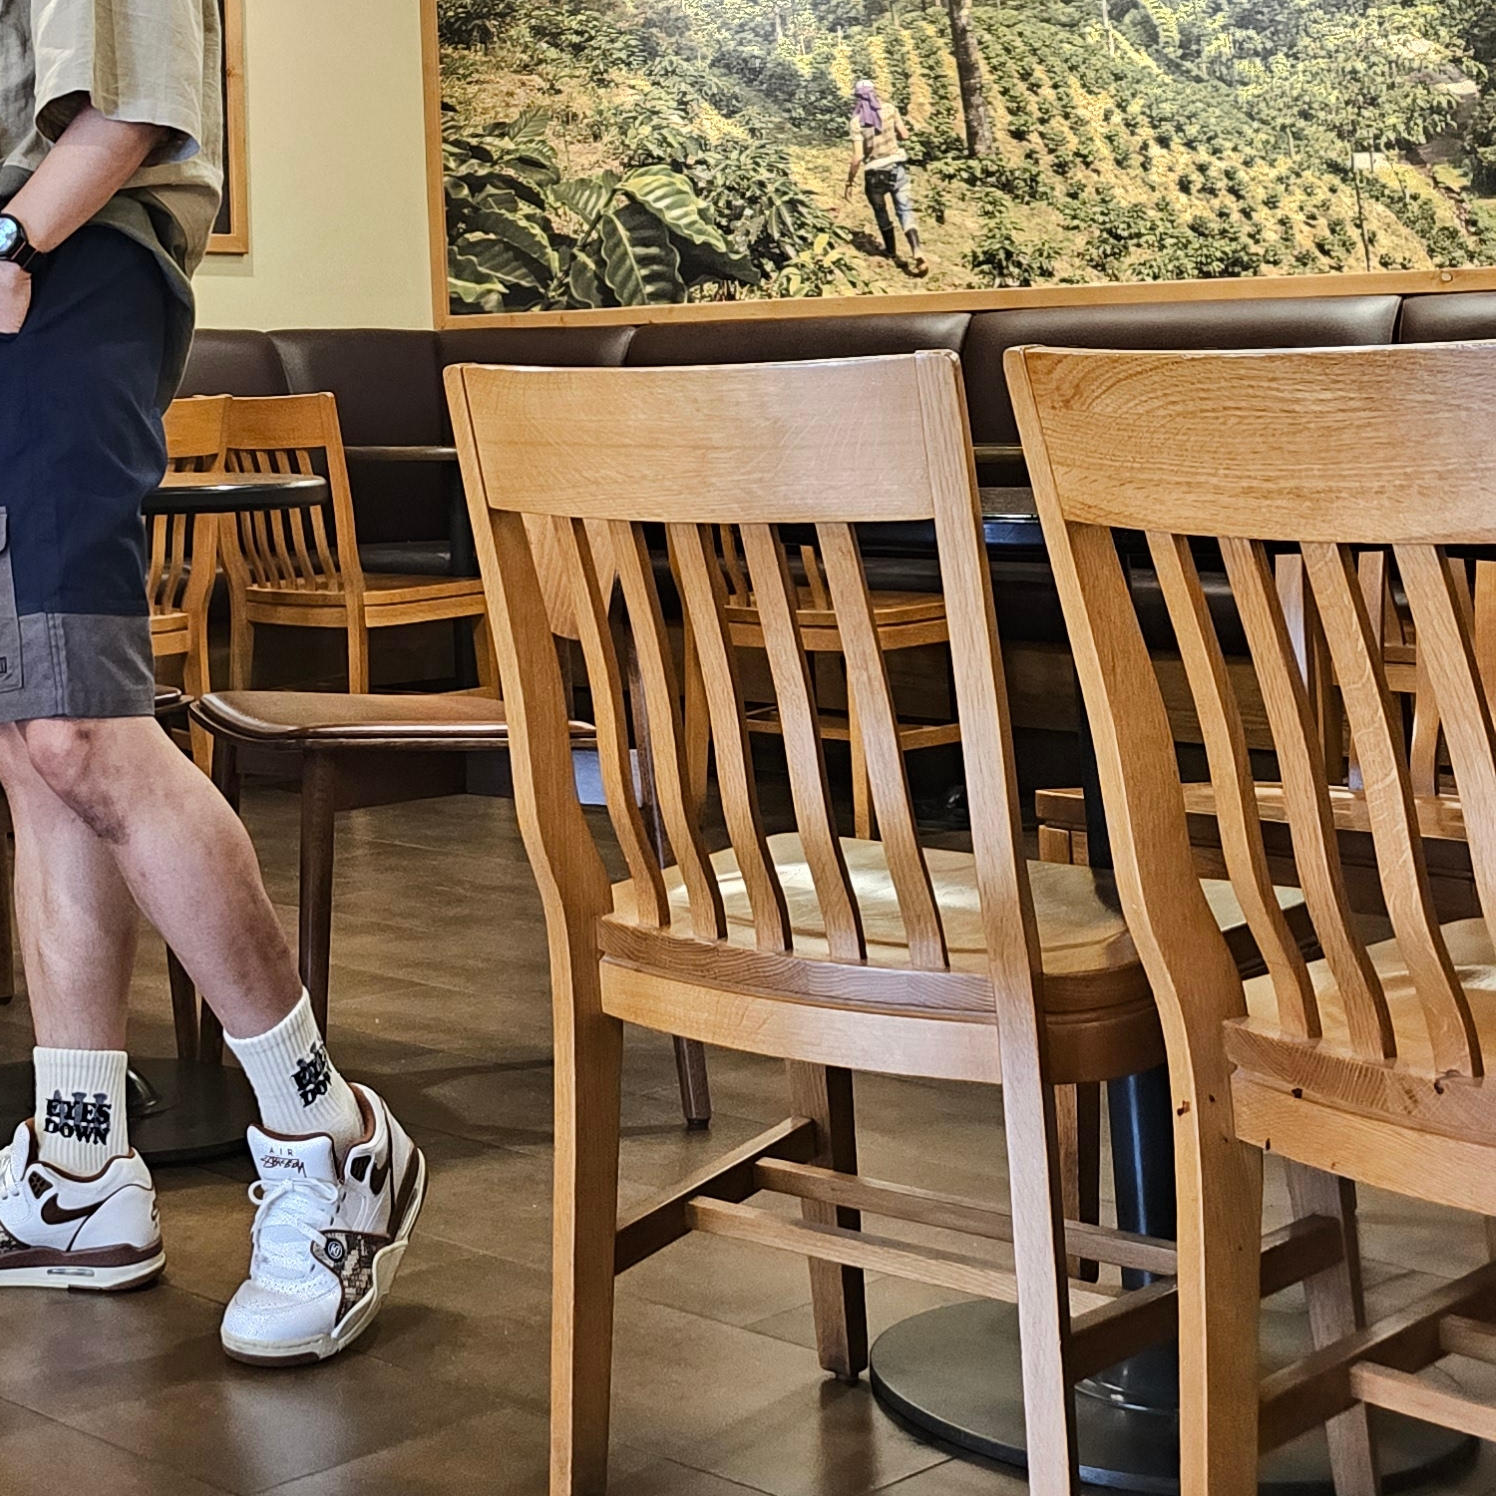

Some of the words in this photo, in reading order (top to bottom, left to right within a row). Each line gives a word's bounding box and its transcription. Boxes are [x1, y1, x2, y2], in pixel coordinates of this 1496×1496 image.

[45, 1098, 112, 1124] EYES
[43, 1118, 111, 1146] DOWN
[269, 1148, 294, 1157] AIR
